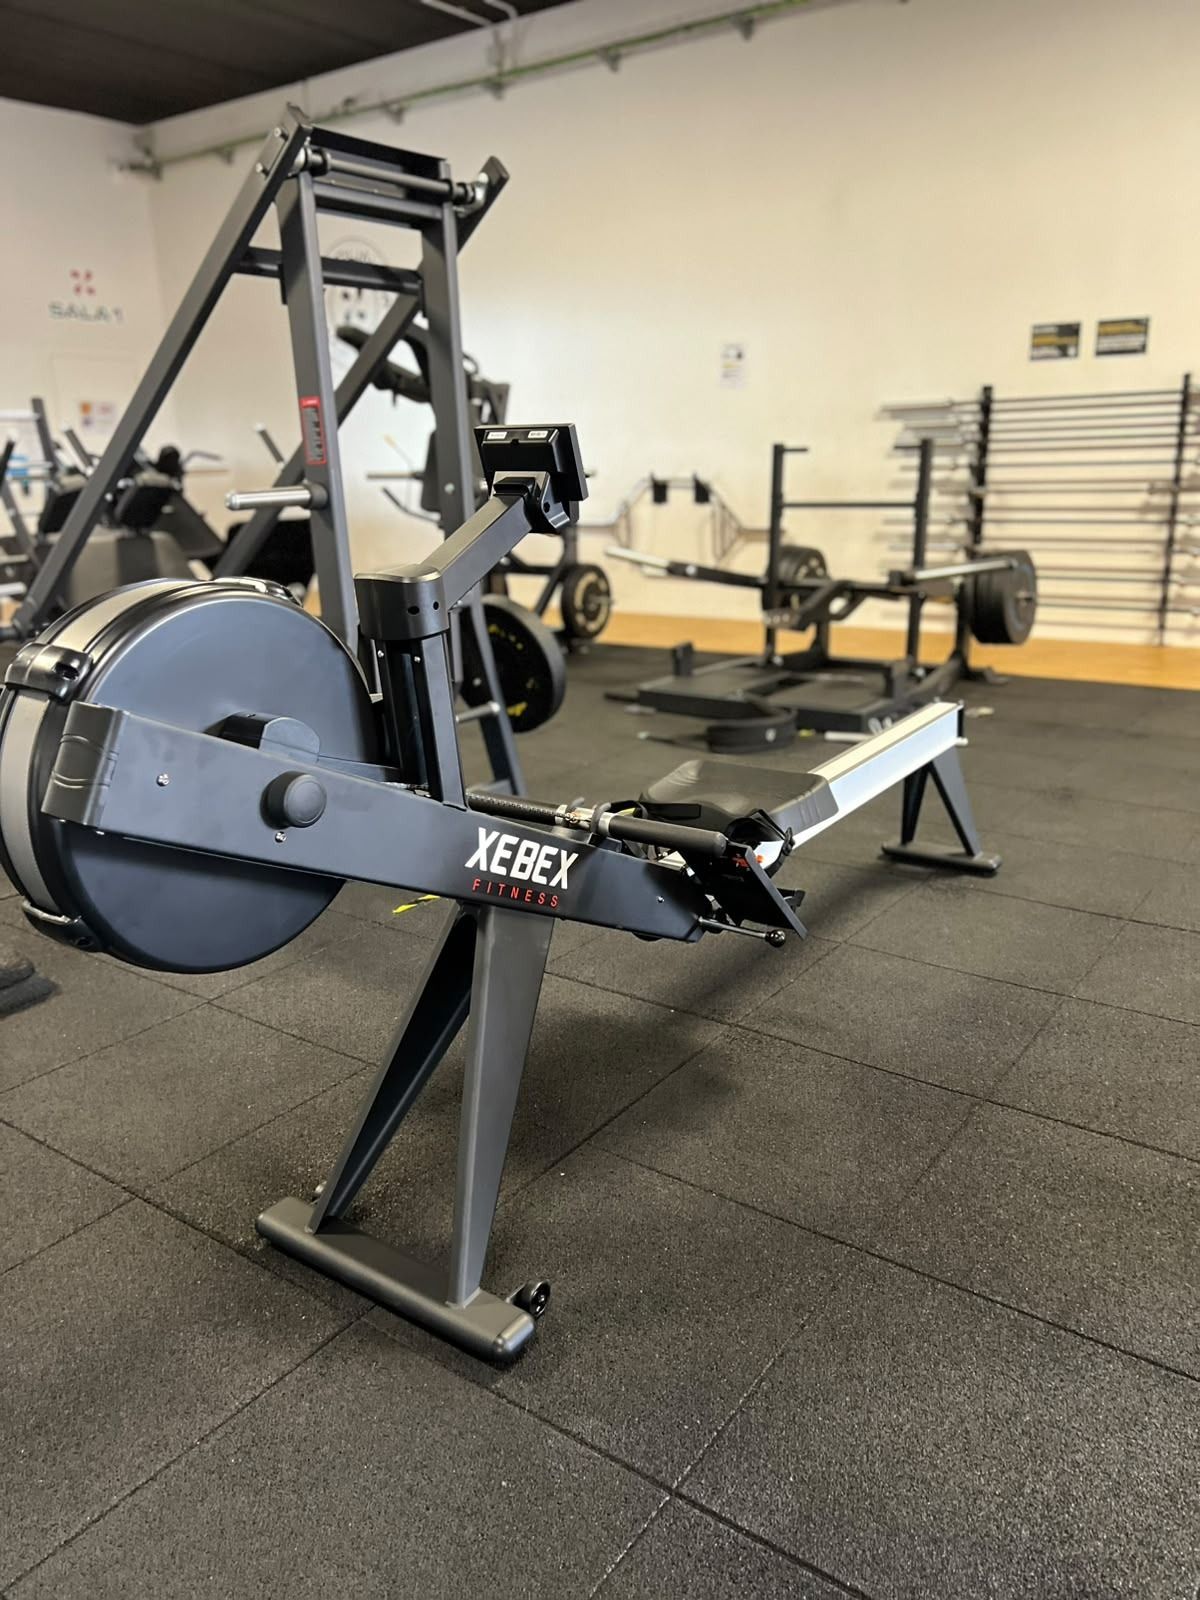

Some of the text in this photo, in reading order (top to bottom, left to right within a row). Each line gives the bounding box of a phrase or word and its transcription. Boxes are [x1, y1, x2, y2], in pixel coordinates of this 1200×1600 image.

[49, 301, 124, 324] SALA 1
[464, 827, 579, 890] XEBEX
[472, 878, 559, 907] FITNESS
